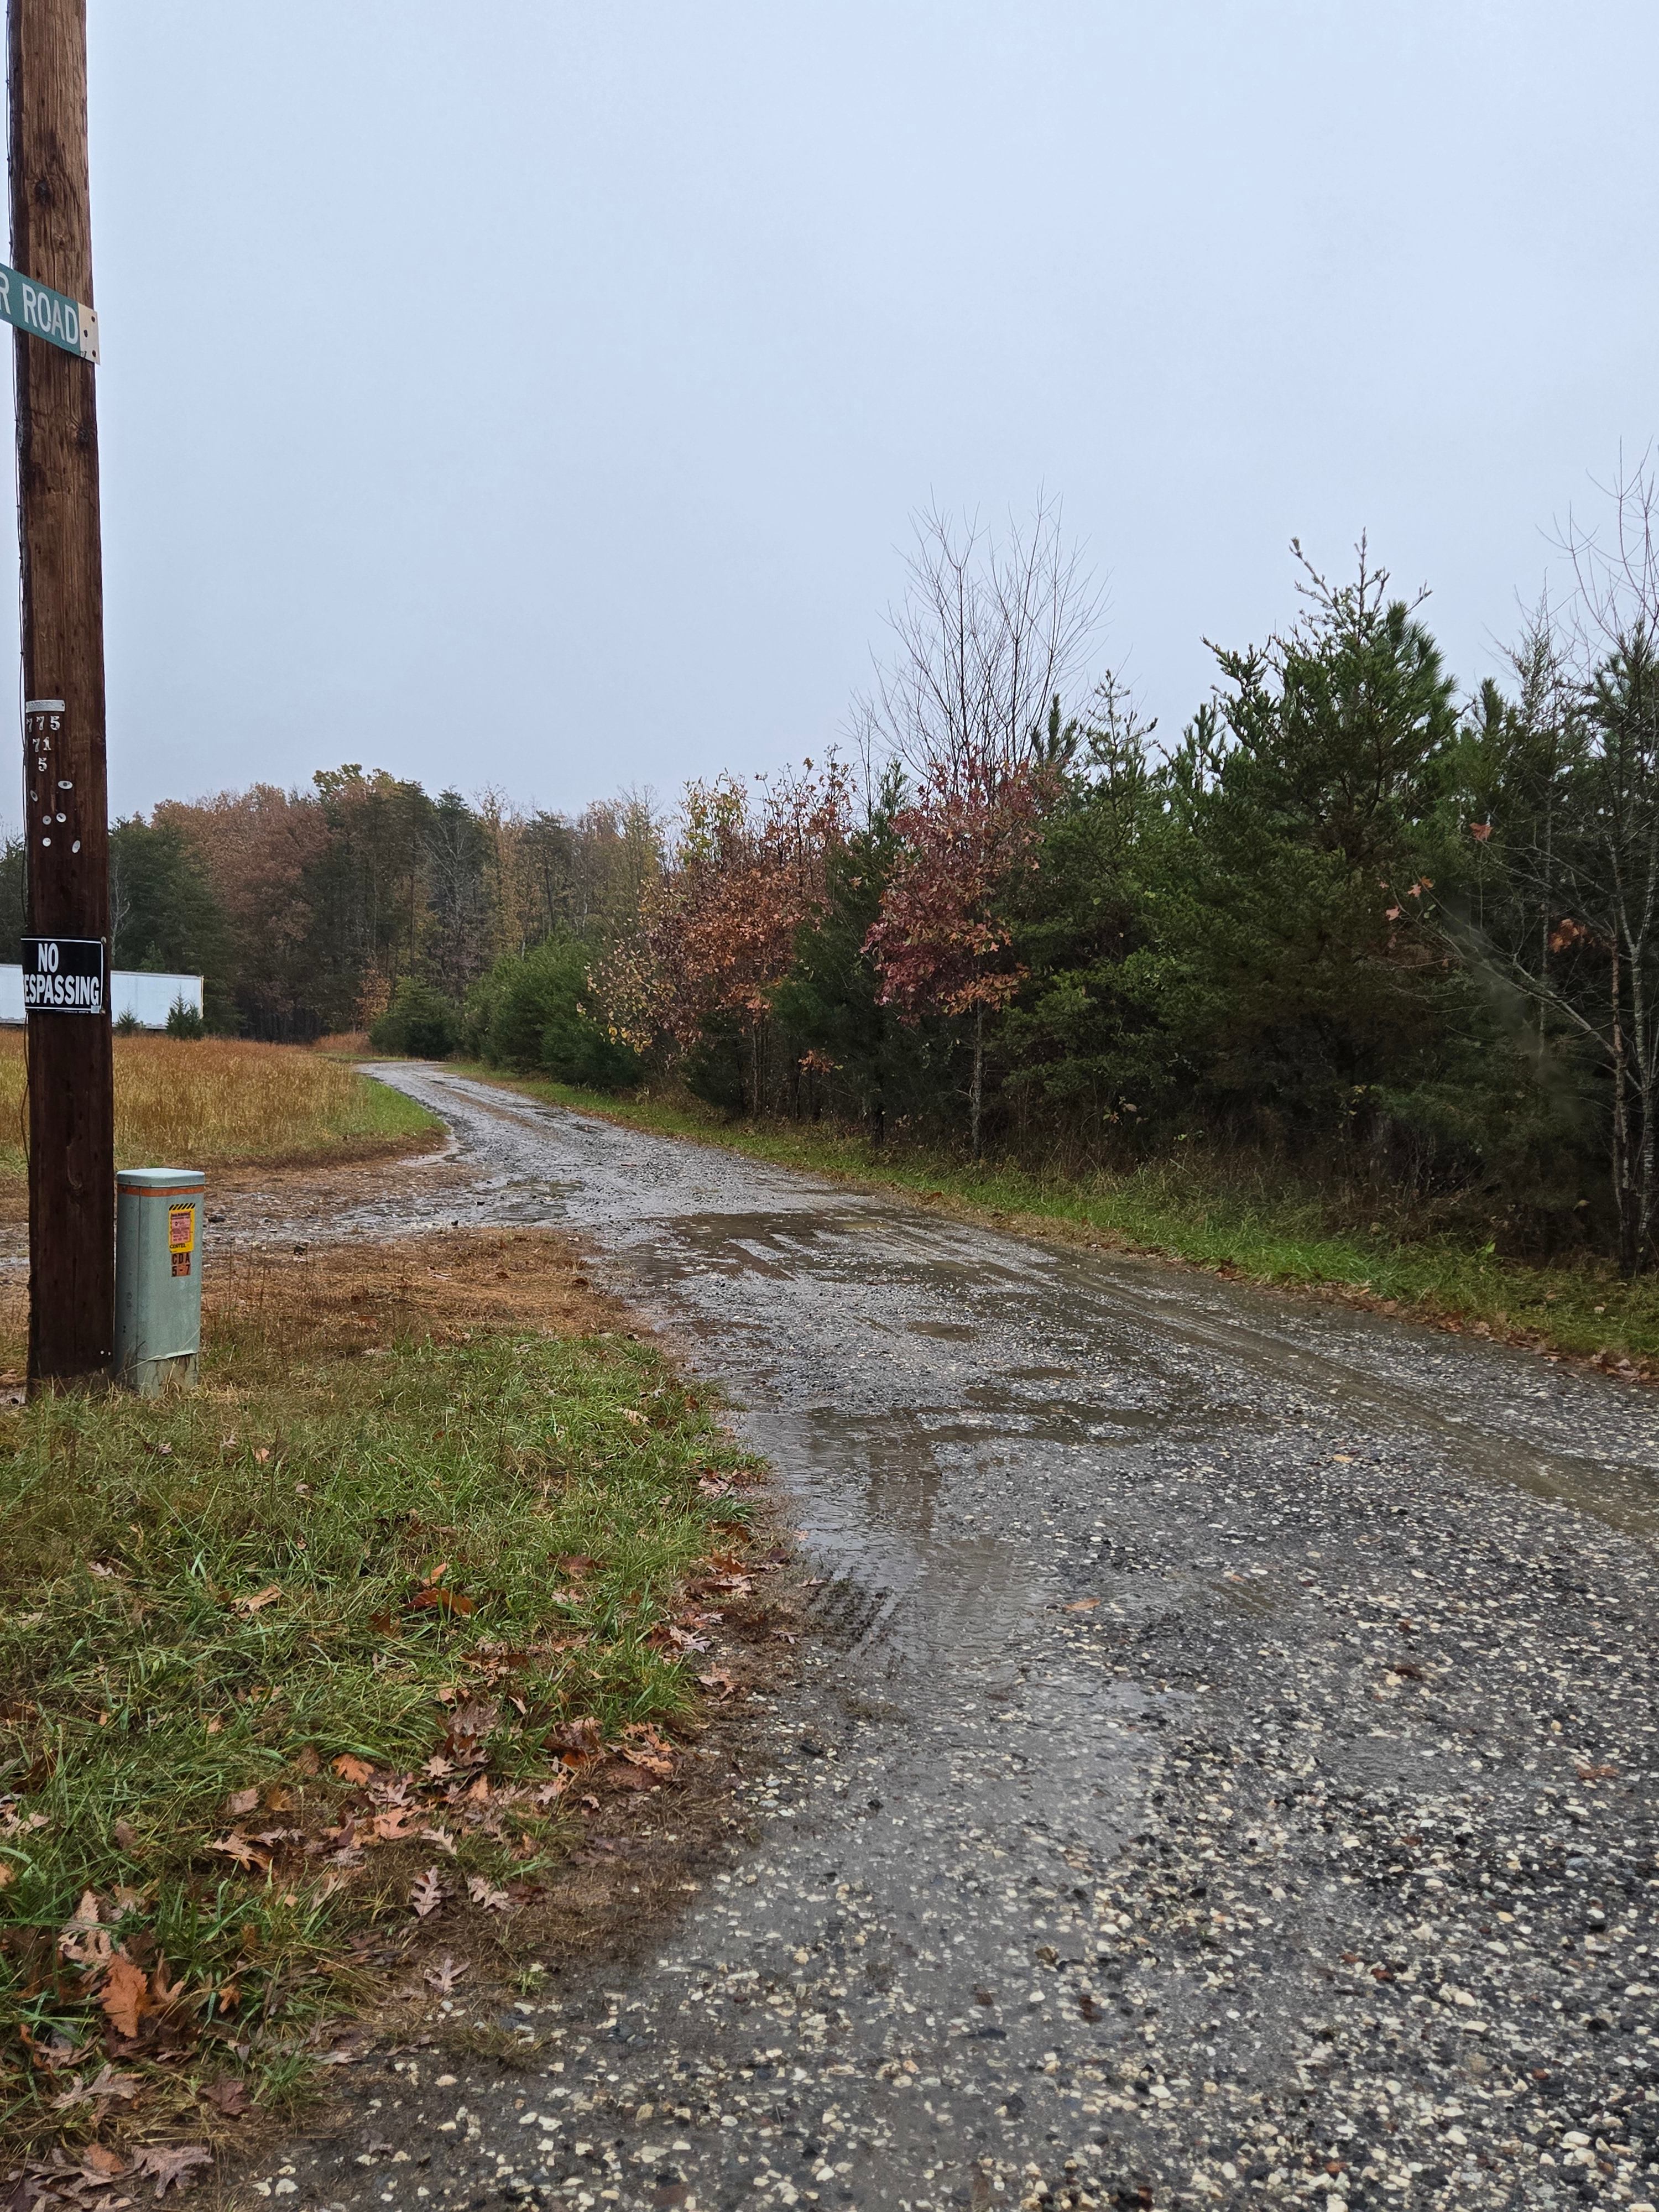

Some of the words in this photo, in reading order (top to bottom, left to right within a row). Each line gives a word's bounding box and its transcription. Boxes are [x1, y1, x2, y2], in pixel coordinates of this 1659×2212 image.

[23, 283, 79, 345] ROAD
[27, 716, 60, 733] 775
[33, 737, 51, 753] 71
[38, 757, 48, 772] 5
[38, 943, 59, 973] NO
[172, 1252, 190, 1265] CDA
